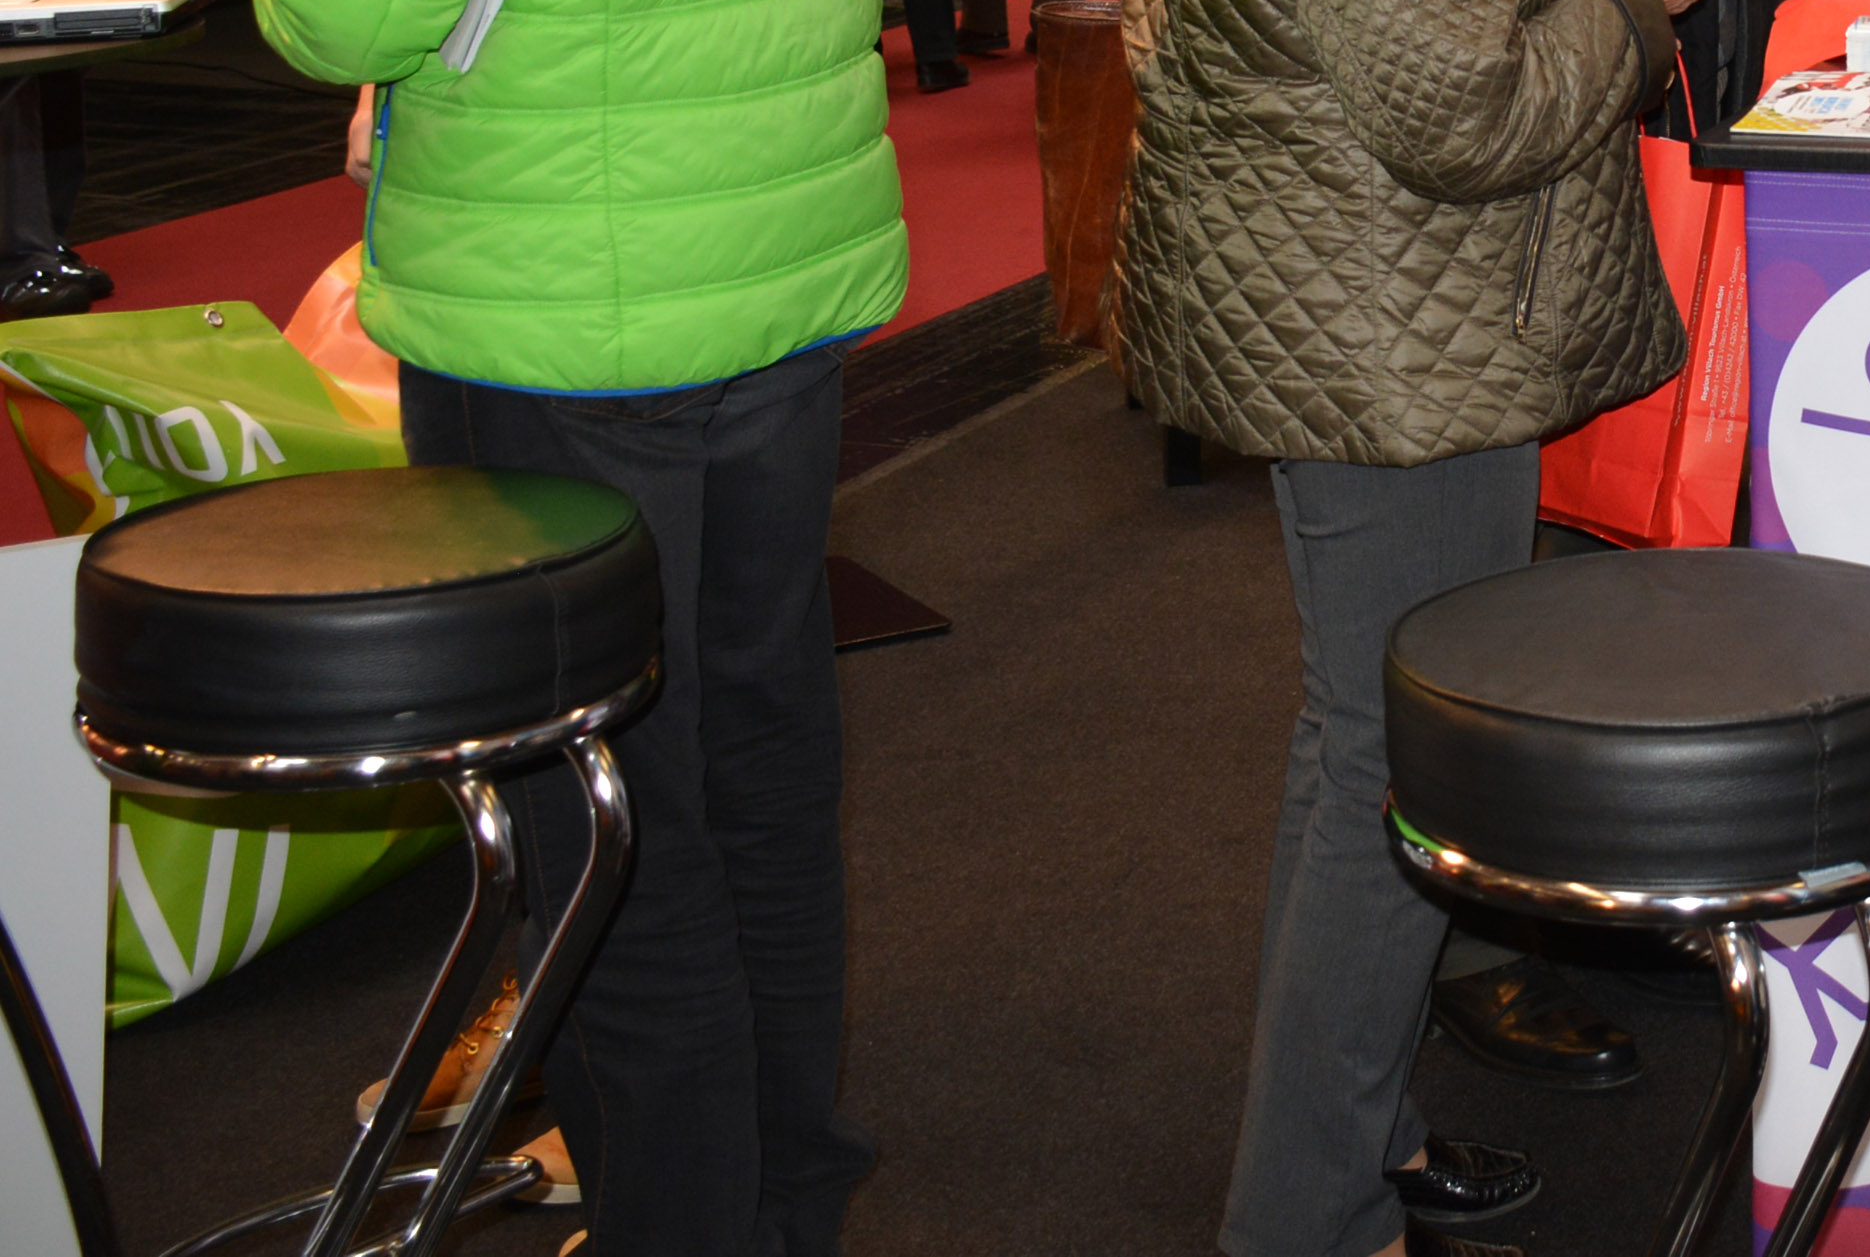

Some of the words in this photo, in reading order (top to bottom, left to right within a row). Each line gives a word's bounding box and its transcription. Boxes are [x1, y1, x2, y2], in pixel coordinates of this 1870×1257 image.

[1715, 285, 1726, 309] GmbH
[1709, 310, 1721, 347] Tourismus
[1705, 348, 1715, 373] Villach
[1700, 375, 1711, 401] Region
